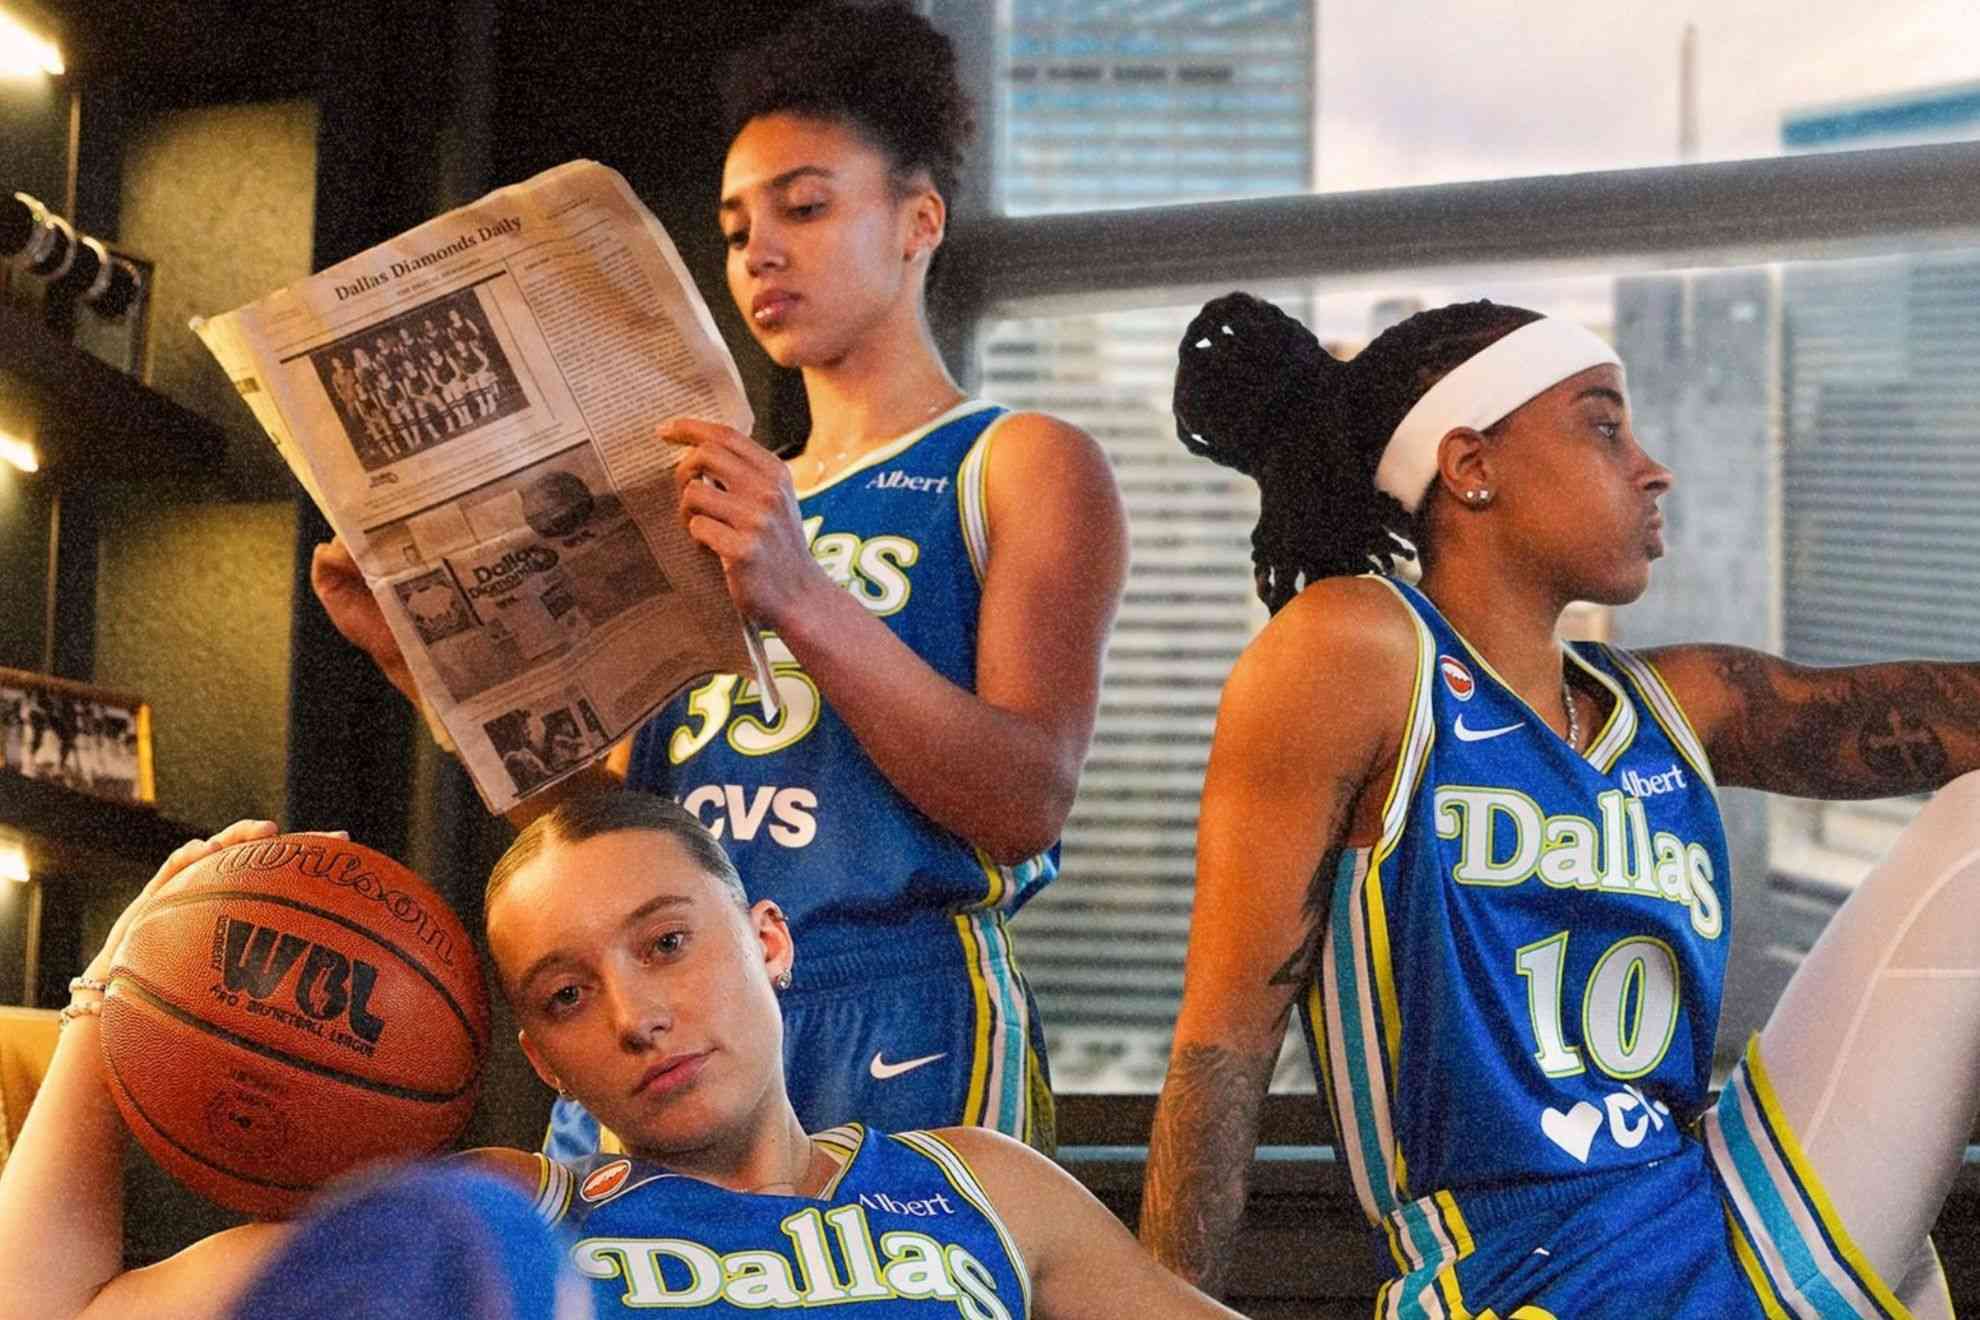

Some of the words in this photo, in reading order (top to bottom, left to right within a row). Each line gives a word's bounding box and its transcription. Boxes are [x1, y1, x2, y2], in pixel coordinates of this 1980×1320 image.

[334, 270, 390, 301] Dallas
[390, 234, 478, 279] Diamonds
[477, 215, 522, 243] Daily
[865, 470, 950, 494] Albert
[682, 783, 818, 849] CVS
[1434, 784, 1722, 940] Dallas
[223, 918, 385, 1044] WBL
[1515, 930, 1681, 1080] 10
[857, 1191, 957, 1219] Albert
[571, 1203, 1013, 1320] Dallas
